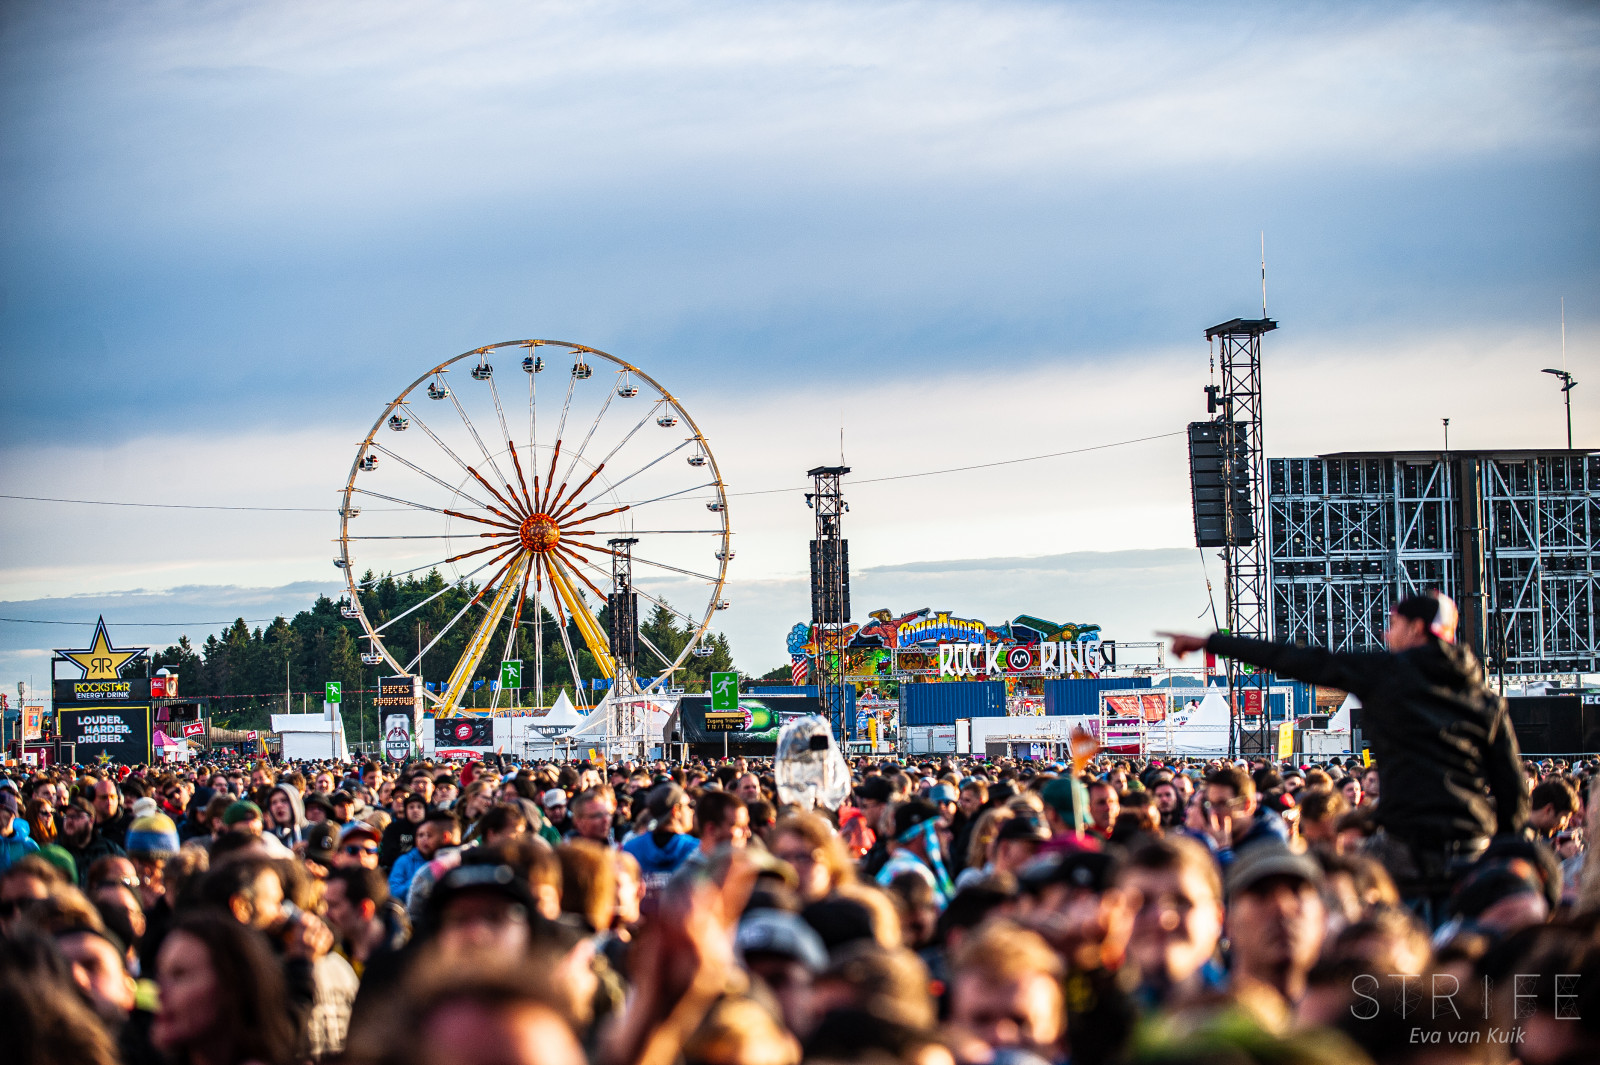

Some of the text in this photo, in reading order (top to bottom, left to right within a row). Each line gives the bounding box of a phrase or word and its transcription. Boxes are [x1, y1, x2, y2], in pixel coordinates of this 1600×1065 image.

[899, 612, 985, 647] COMMANDER
[939, 641, 1101, 677] ROCK AM RING
[77, 715, 124, 725] LOUDER.
[84, 725, 132, 734] HARDER.
[77, 732, 124, 744] DRÜBER.
